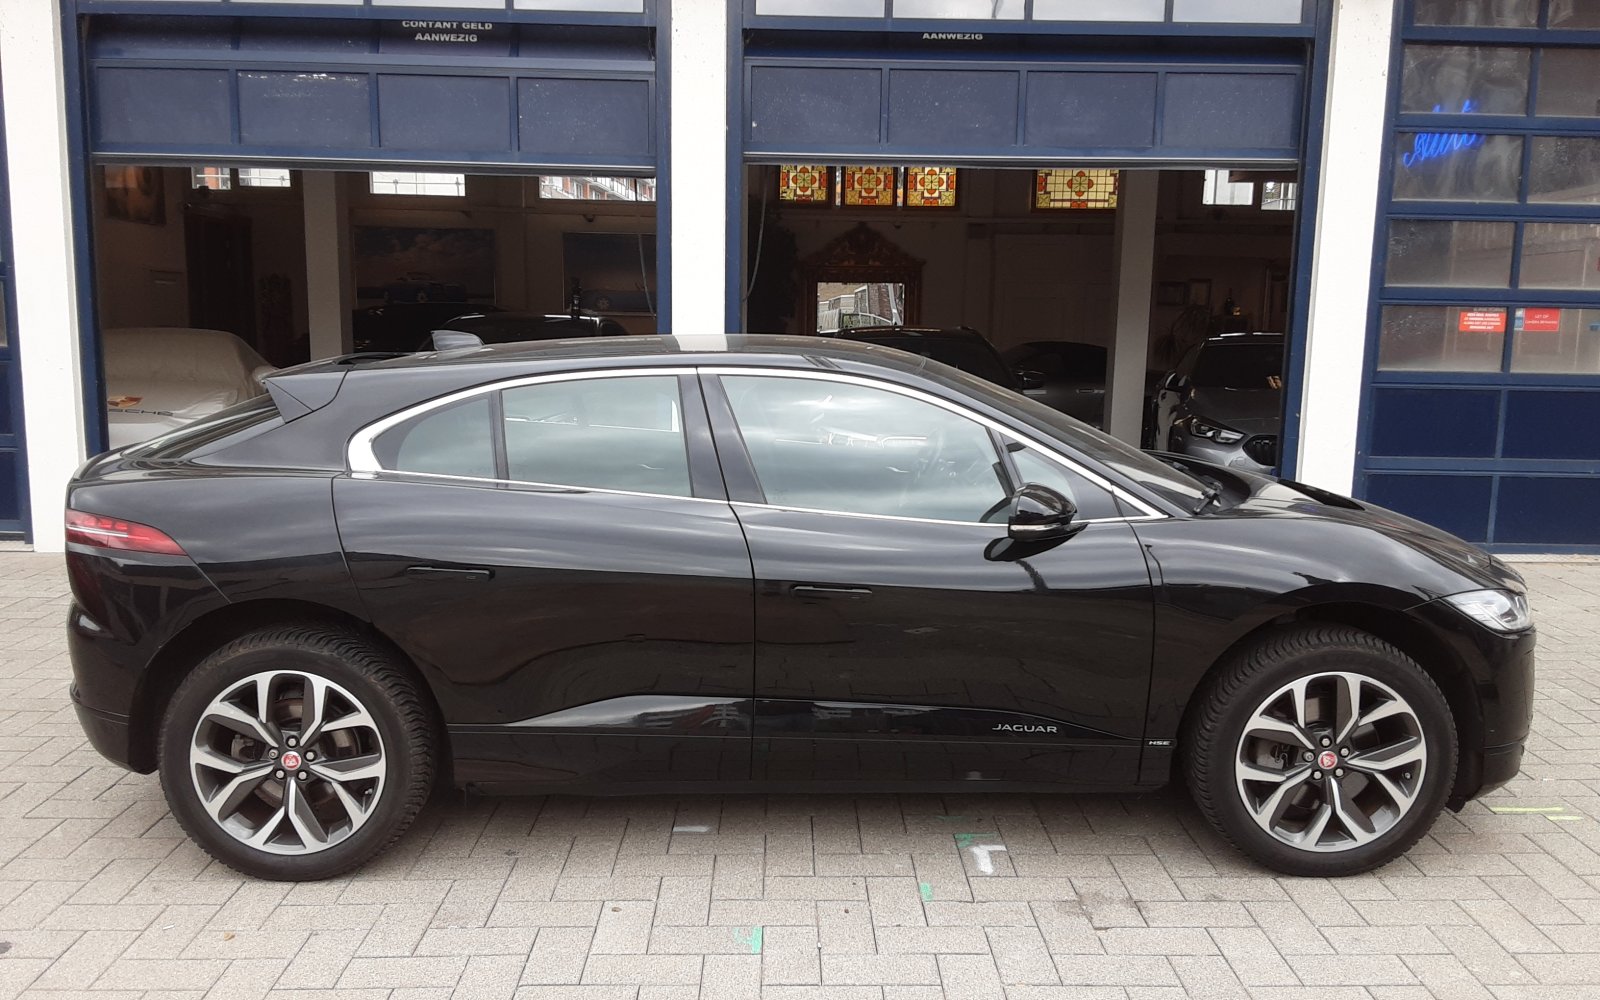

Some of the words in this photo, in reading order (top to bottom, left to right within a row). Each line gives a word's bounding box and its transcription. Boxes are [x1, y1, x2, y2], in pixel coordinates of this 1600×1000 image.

[402, 20, 459, 29] CONTANT
[462, 22, 493, 30] GELD
[414, 32, 478, 42] AANWEZIG
[922, 32, 984, 40] AANWEZIG
[992, 723, 1058, 734] JAGUAR
